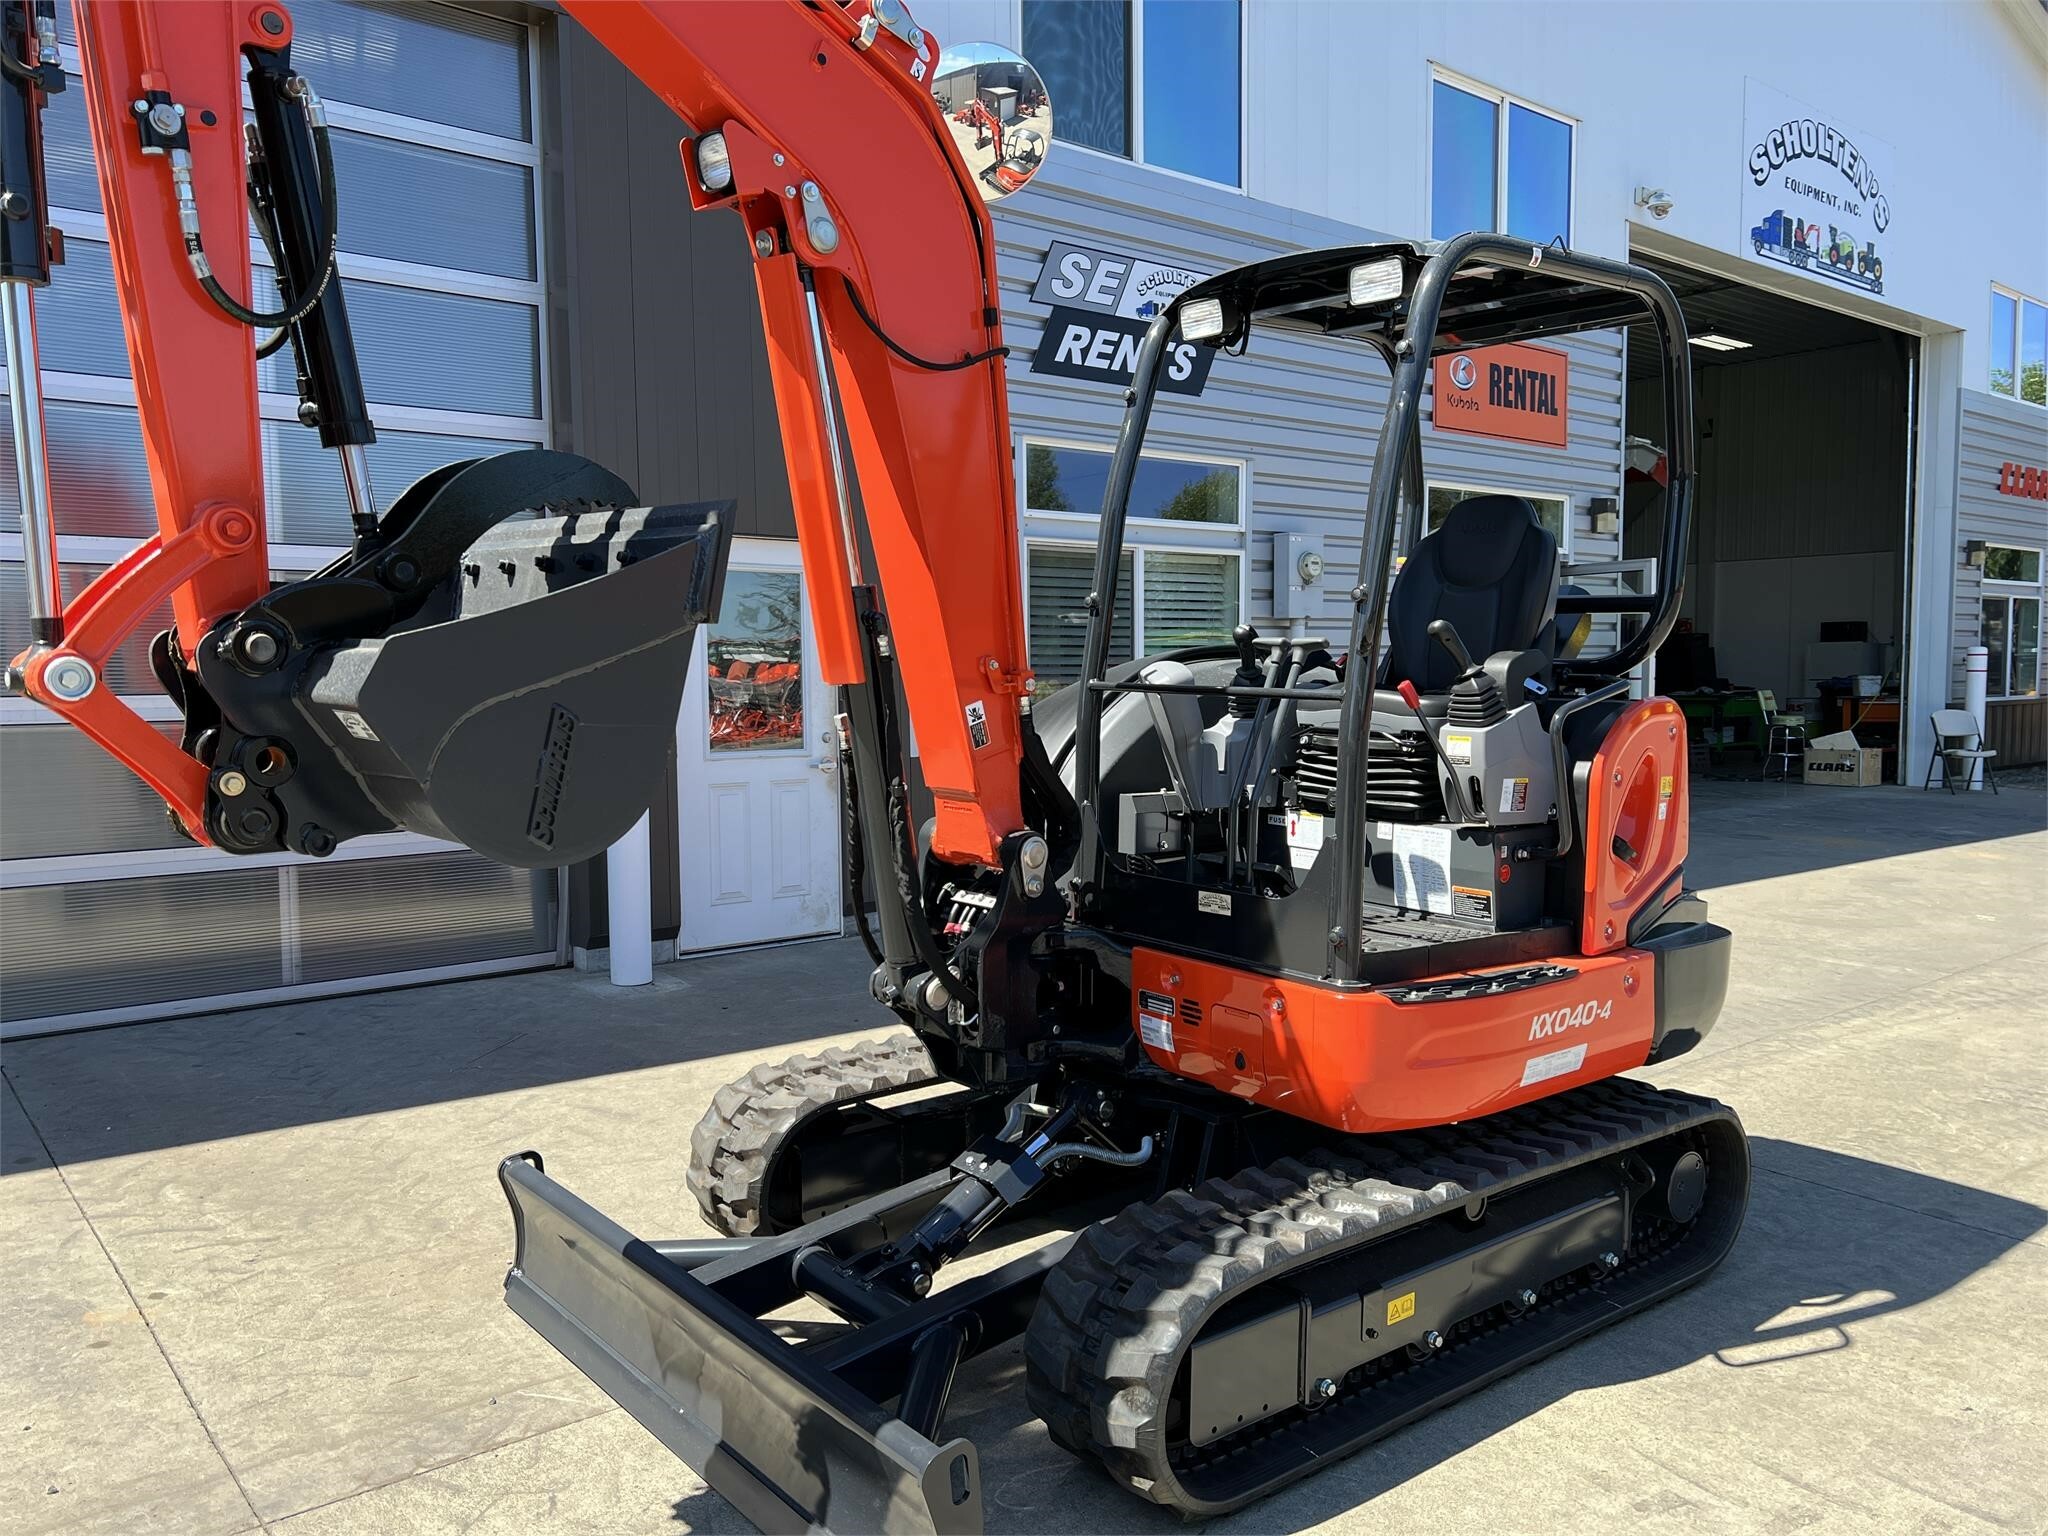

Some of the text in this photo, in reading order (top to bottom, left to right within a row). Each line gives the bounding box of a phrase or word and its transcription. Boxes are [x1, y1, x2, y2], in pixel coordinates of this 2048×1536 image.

[1750, 119, 1890, 233] SCHOLTEN'S
[1784, 176, 1862, 217] EQUIPMENT, INC.
[1136, 269, 1198, 296] SCHOLTE
[1054, 324, 1197, 381] RENS
[1447, 393, 1480, 411] Kubota
[1489, 363, 1558, 416] RENTAL
[2000, 462, 2048, 501] CLAA
[1528, 1000, 1613, 1041] KX040-4
